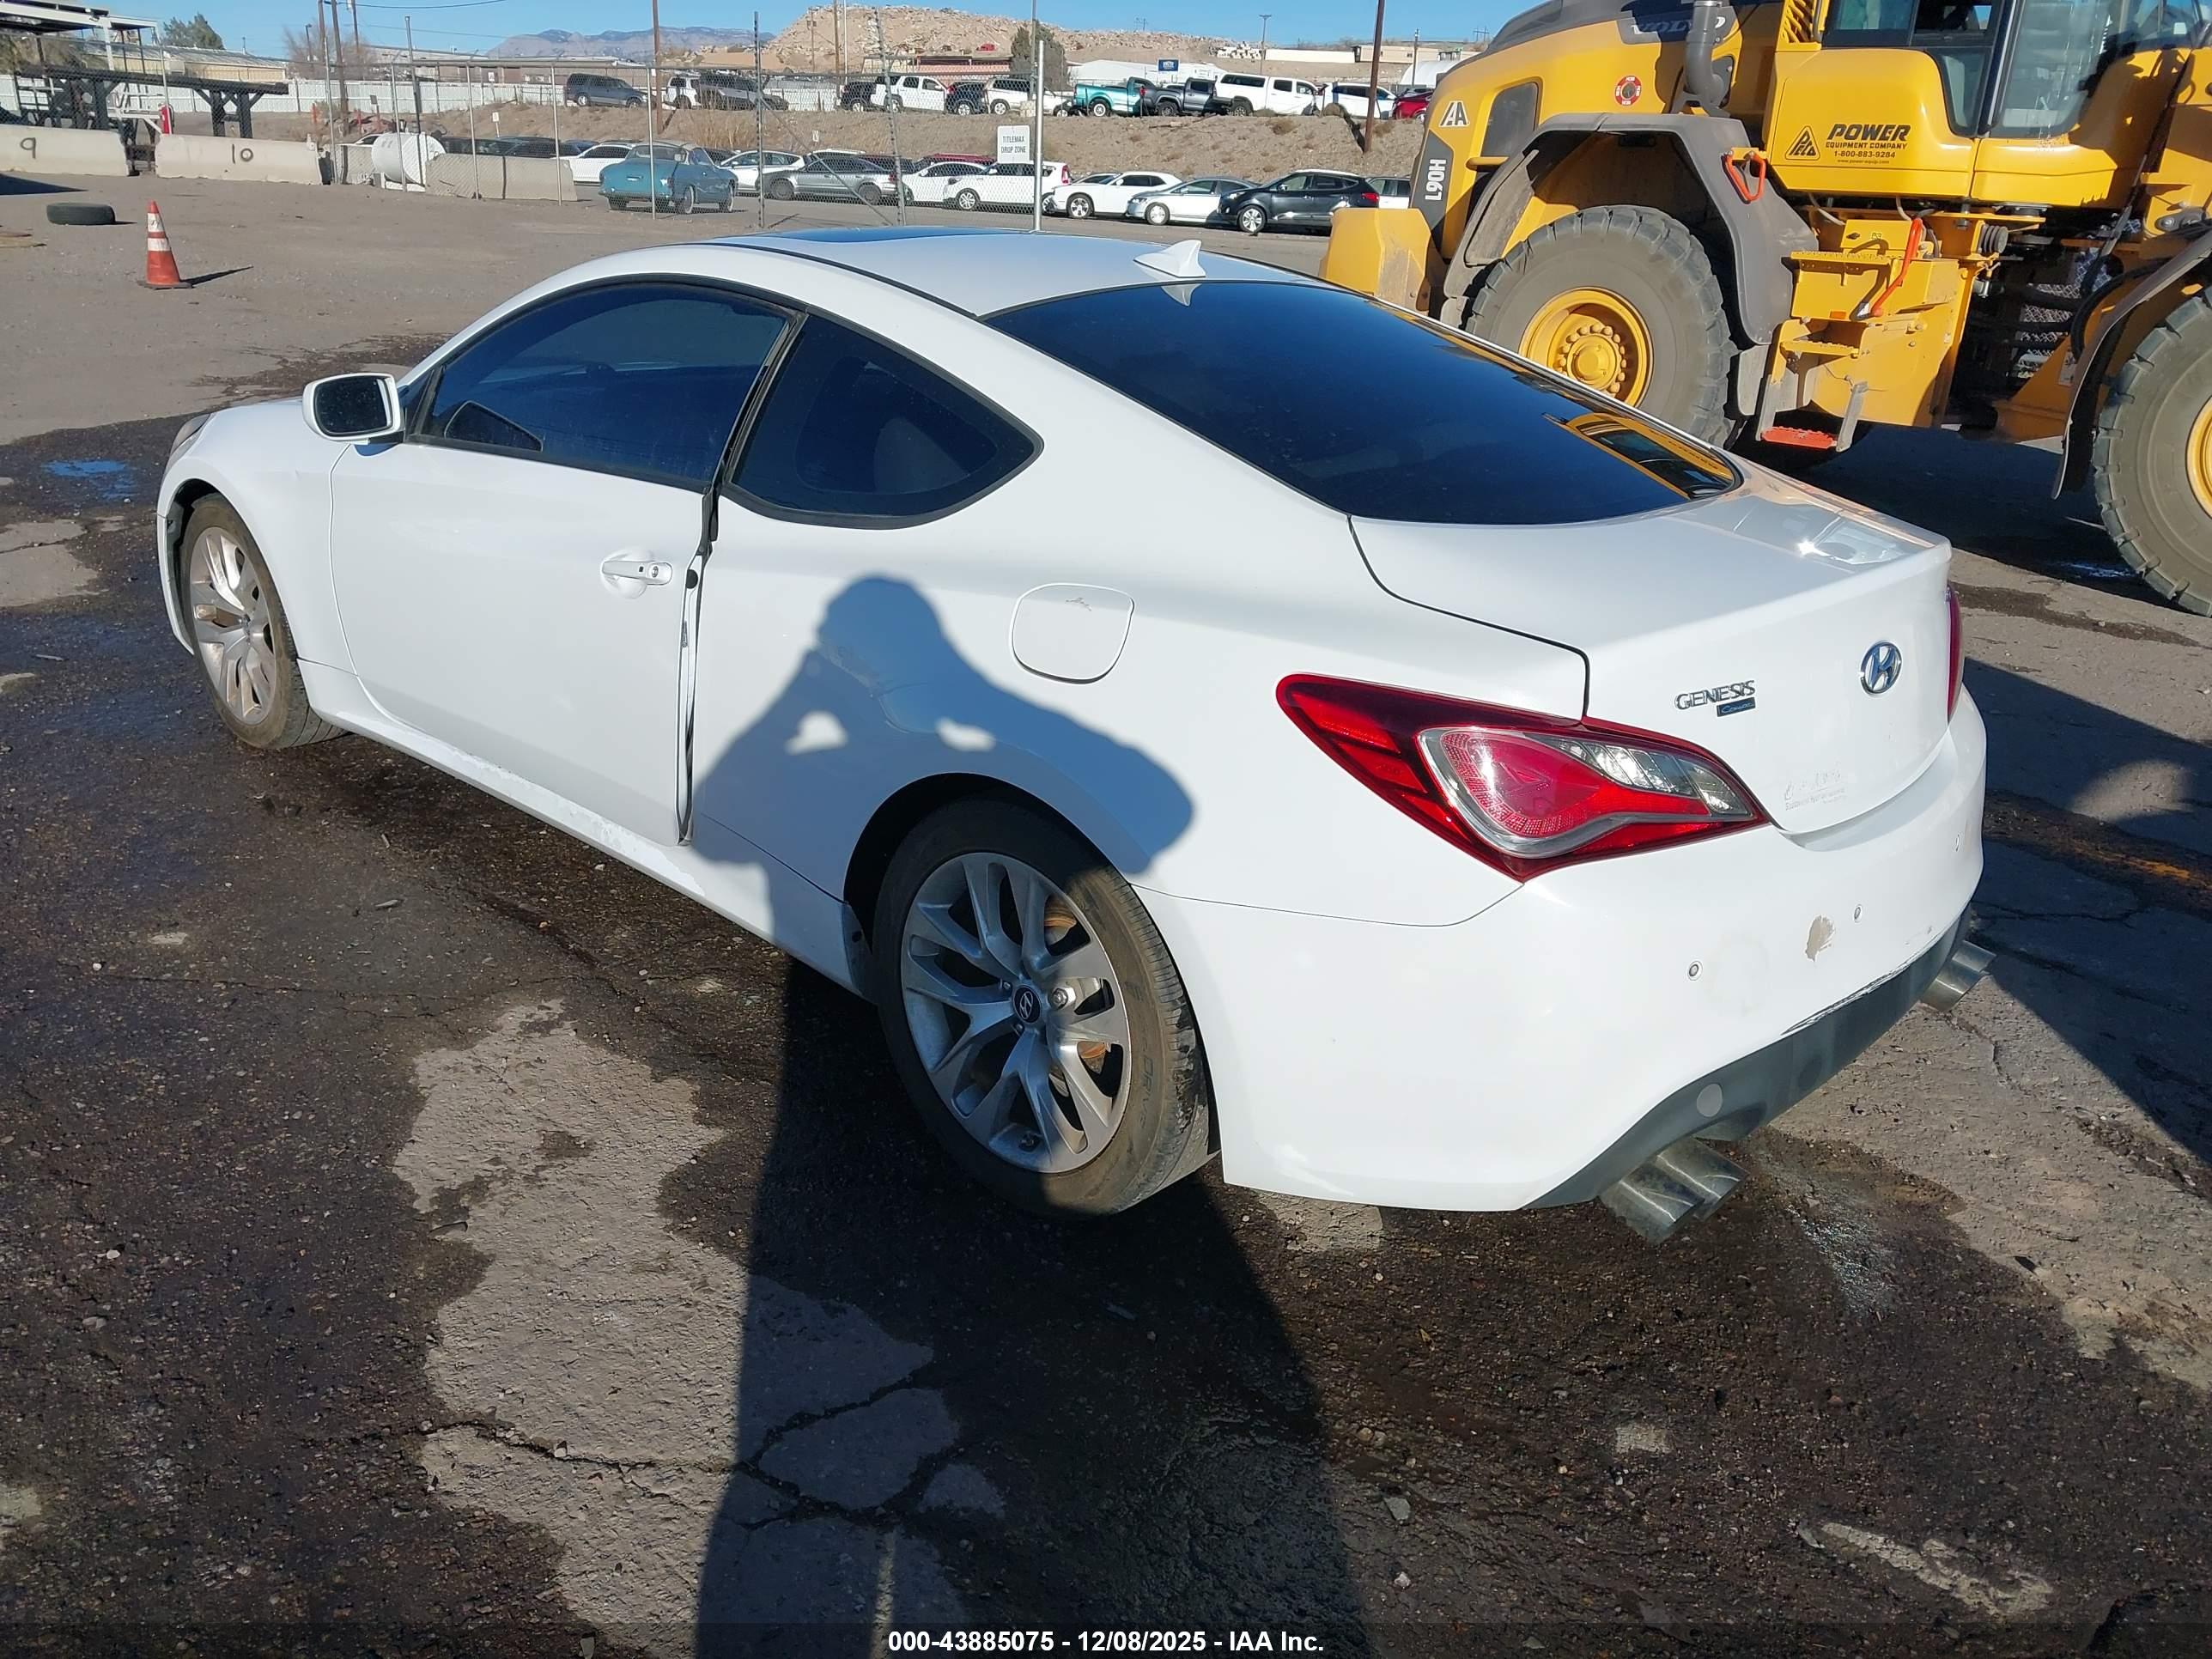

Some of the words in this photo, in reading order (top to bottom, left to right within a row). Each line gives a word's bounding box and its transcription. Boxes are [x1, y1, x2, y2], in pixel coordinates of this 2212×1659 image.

[1826, 124, 1911, 141] POWER
[20, 137, 36, 159] 9
[1869, 142, 1908, 150] COMPANY
[1425, 159, 1447, 201] L90H
[1674, 680, 1756, 709] GENESIS
